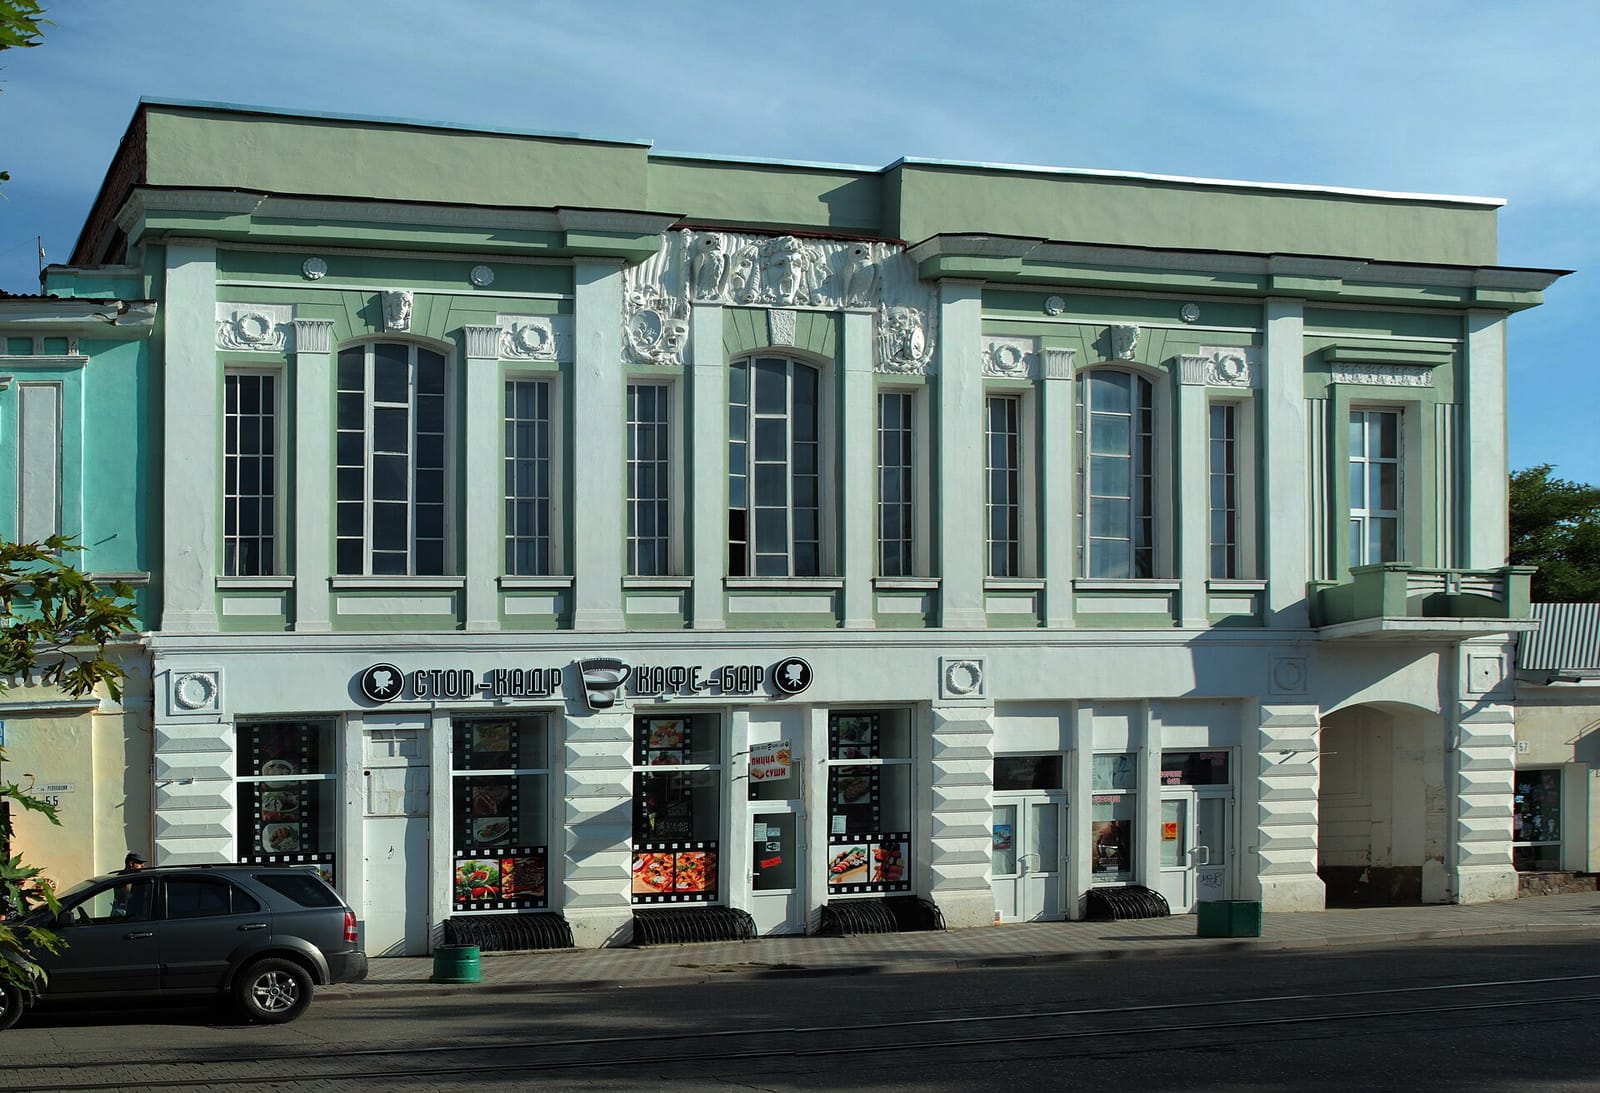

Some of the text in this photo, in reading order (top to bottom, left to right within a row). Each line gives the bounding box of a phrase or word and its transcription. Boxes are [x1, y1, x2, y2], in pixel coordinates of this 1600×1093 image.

[412, 665, 764, 698] СТОП-КАДР КАФЕ-БАР
[751, 755, 775, 766] ПИЦЦА
[765, 768, 786, 777] СУШИ
